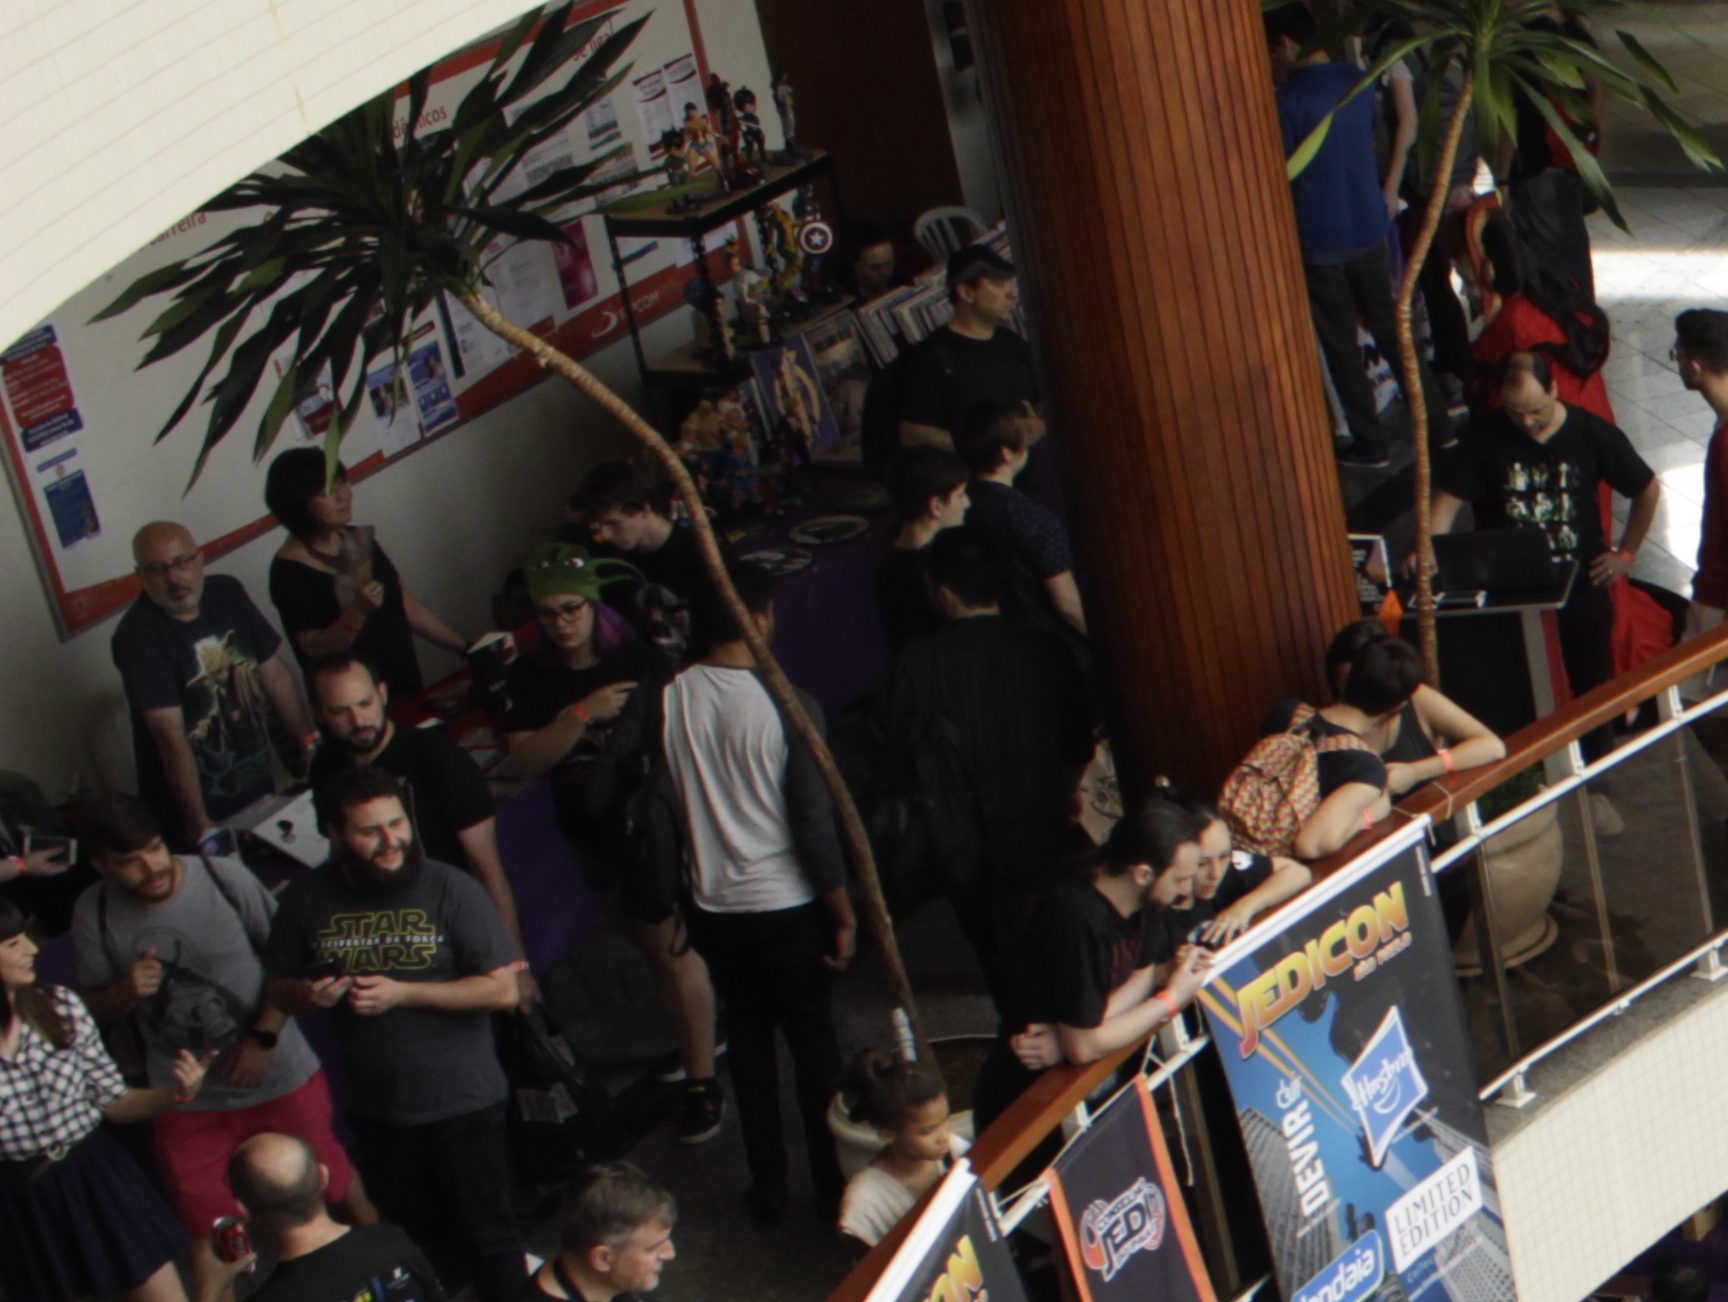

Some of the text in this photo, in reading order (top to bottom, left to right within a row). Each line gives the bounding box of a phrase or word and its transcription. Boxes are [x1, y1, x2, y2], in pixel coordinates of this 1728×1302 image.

[317, 909, 436, 940] STAR
[1236, 881, 1409, 1059] JEDICON
[1352, 1047, 1413, 1112] Hasbro
[1281, 1099, 1331, 1218] DEVIR
[1101, 1191, 1152, 1279] JEDI
[1393, 1162, 1471, 1236] LIMITED
[1400, 1188, 1474, 1258] EDITION
